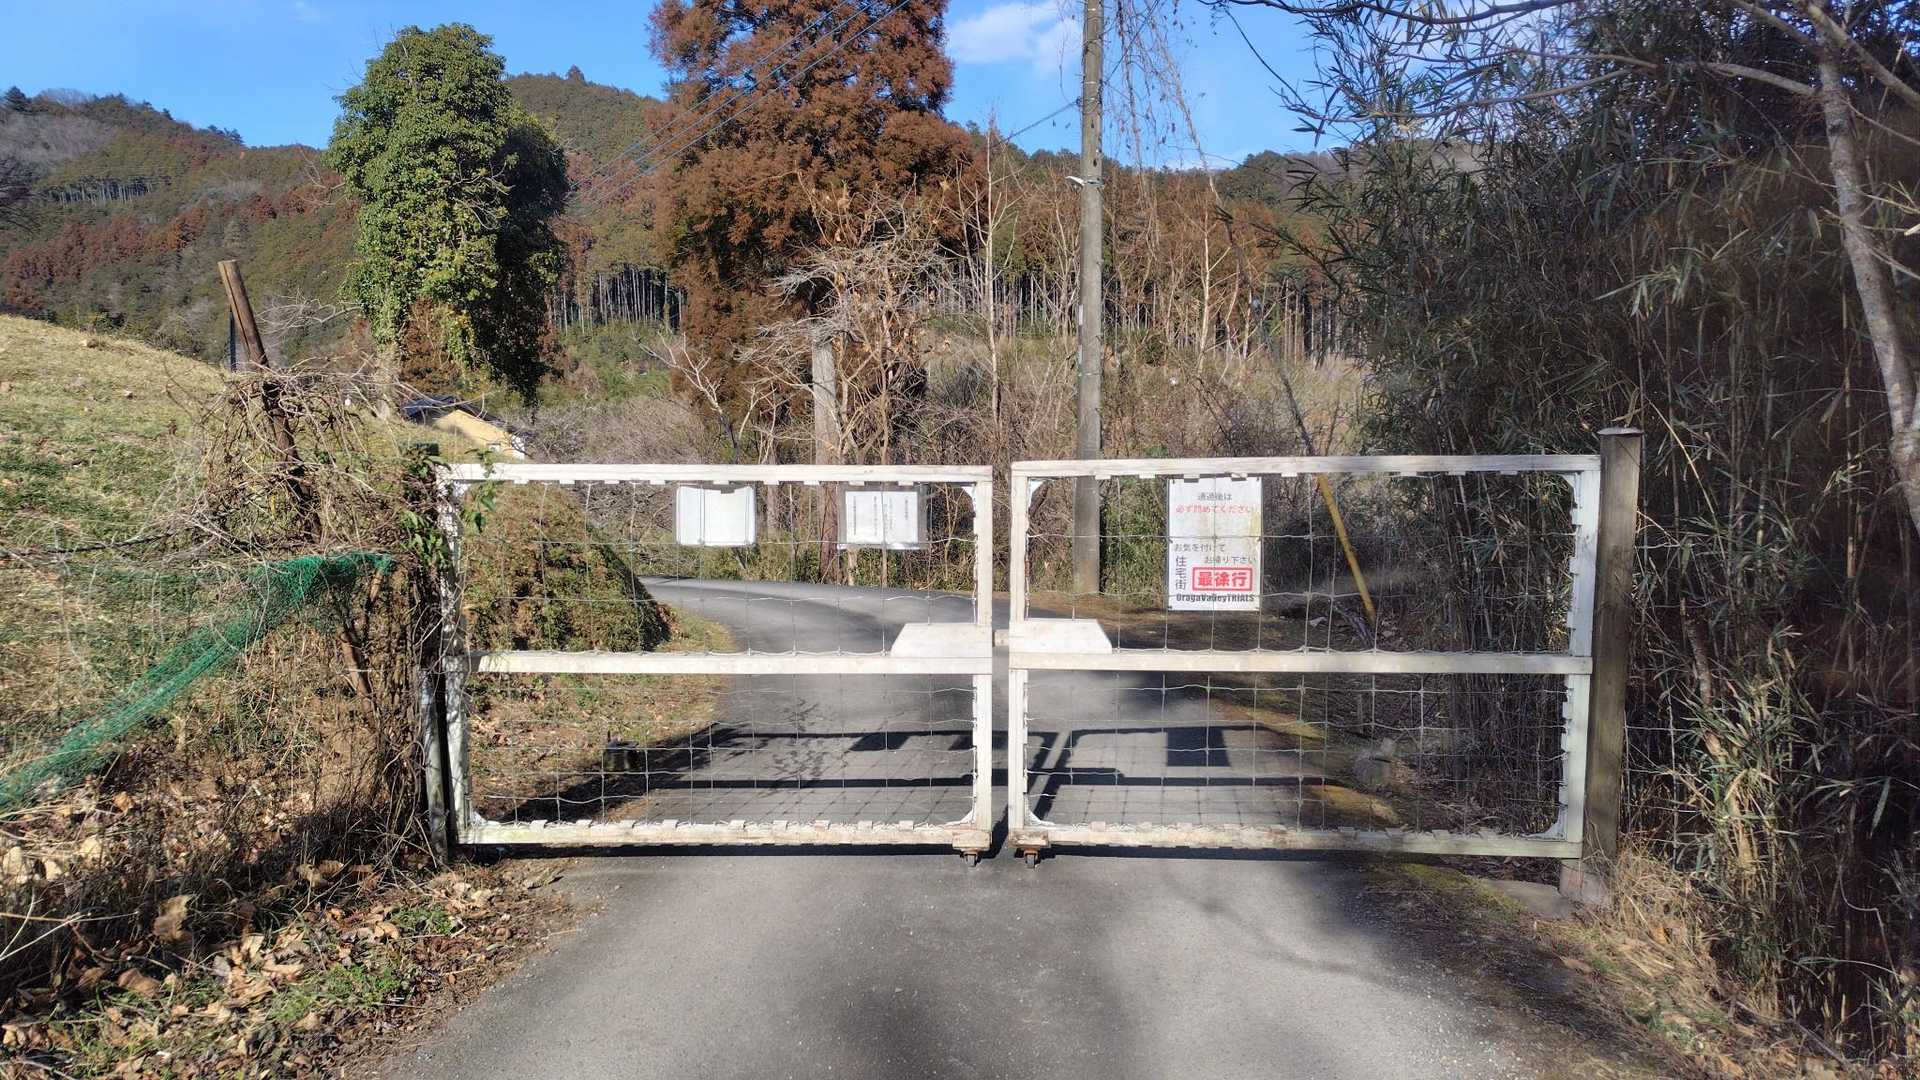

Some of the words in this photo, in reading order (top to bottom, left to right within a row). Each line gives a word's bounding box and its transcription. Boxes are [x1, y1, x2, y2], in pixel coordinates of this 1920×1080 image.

[1175, 543, 1226, 552] お気を付けて
[1176, 556, 1186, 590] 住宅街
[1199, 572, 1247, 587] 最徐行
